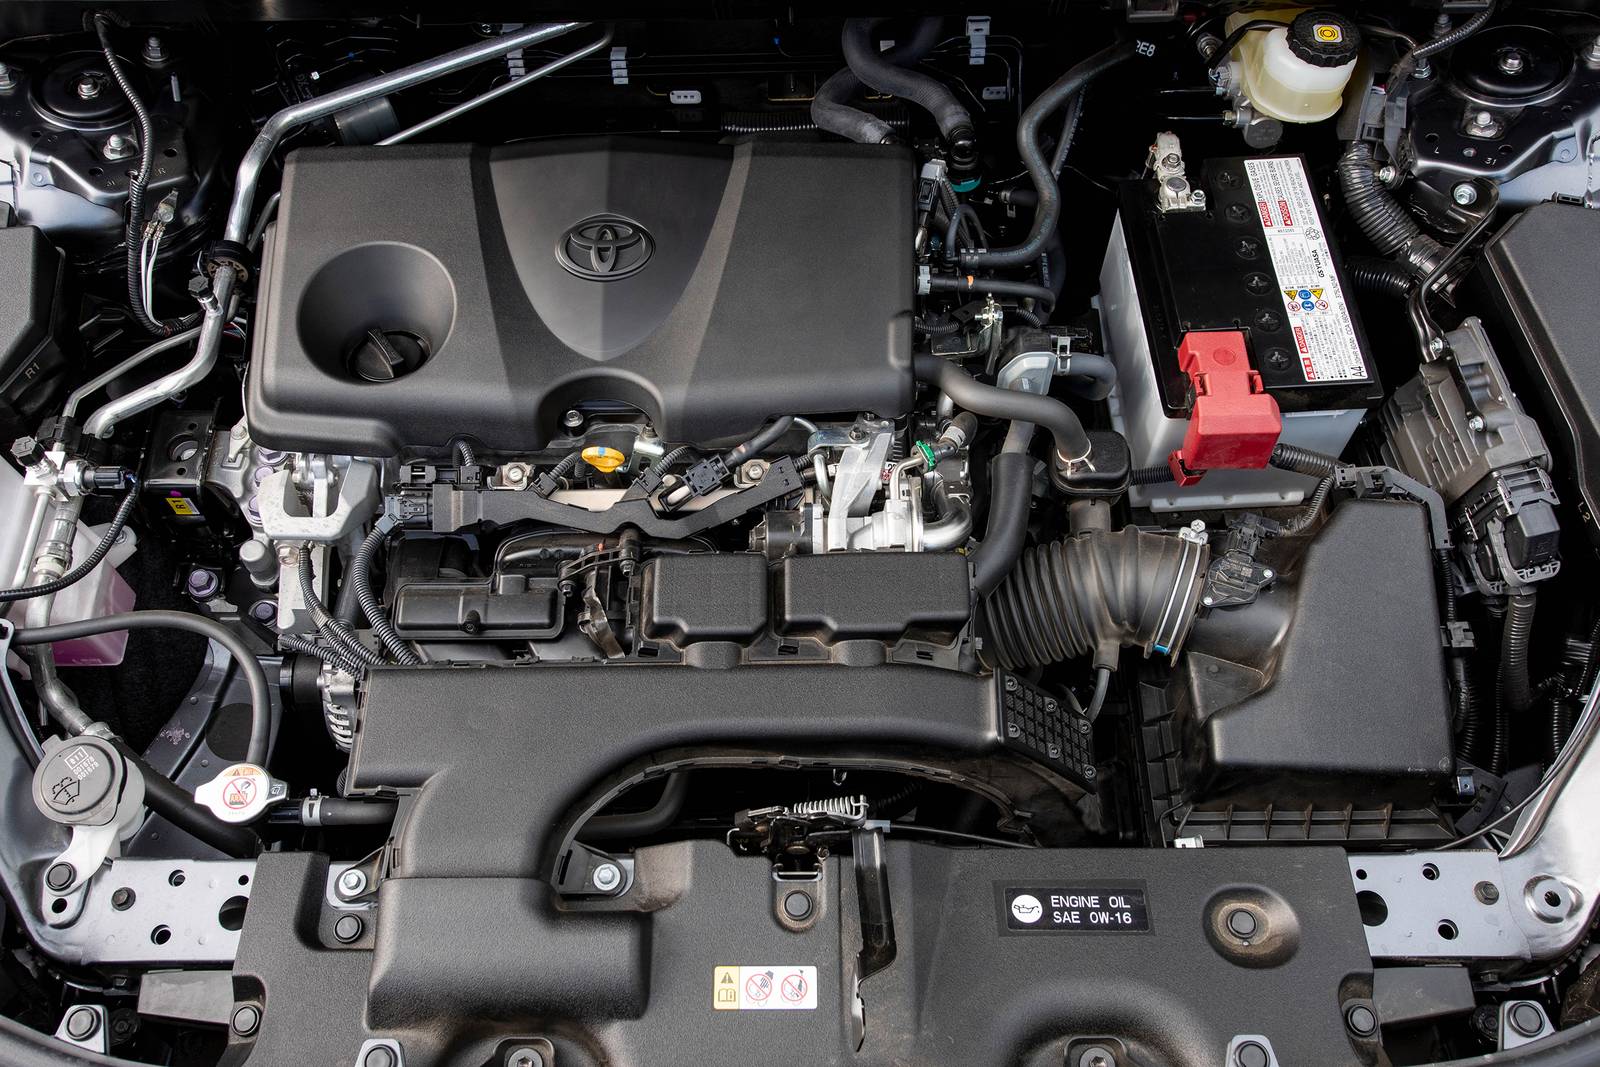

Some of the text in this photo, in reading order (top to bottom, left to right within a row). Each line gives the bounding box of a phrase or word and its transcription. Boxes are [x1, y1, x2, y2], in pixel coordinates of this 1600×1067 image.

[1247, 162, 1270, 221] DANGER EXPLOSIVE GASES
[1278, 201, 1290, 220] POISON
[1311, 249, 1322, 269] YUASA
[1294, 327, 1306, 347] DANGER
[25, 362, 40, 378] R1
[1350, 365, 1365, 377] A4
[1050, 896, 1131, 908] ENGINE OIL
[1053, 911, 1132, 924] SAE 0W-16
